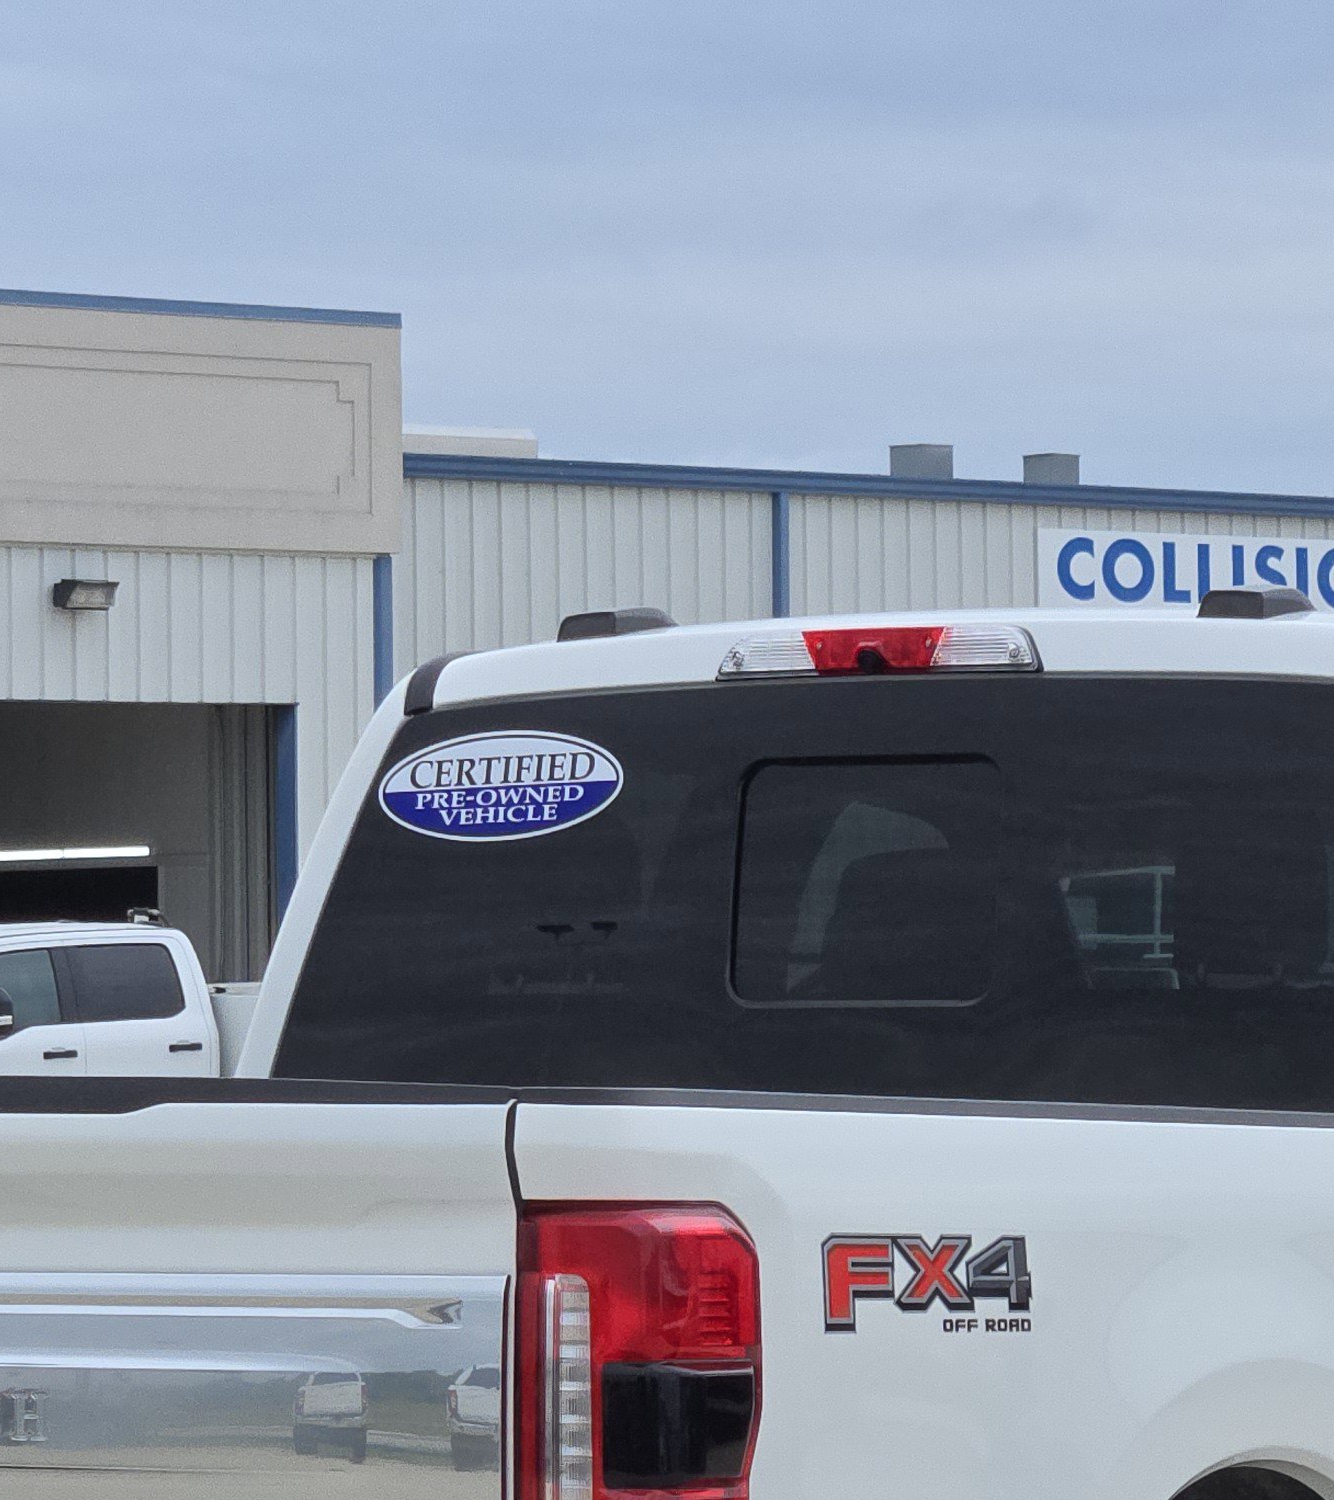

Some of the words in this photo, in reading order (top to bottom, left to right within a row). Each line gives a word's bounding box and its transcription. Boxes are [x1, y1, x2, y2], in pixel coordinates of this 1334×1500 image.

[410, 751, 596, 788] CERTIFIED
[415, 785, 585, 810] PRE-OWNED
[439, 804, 558, 826] VEHICLE
[821, 1233, 1032, 1334] FX4
[943, 1318, 979, 1333] OFF
[985, 1318, 1032, 1333] ROAD
